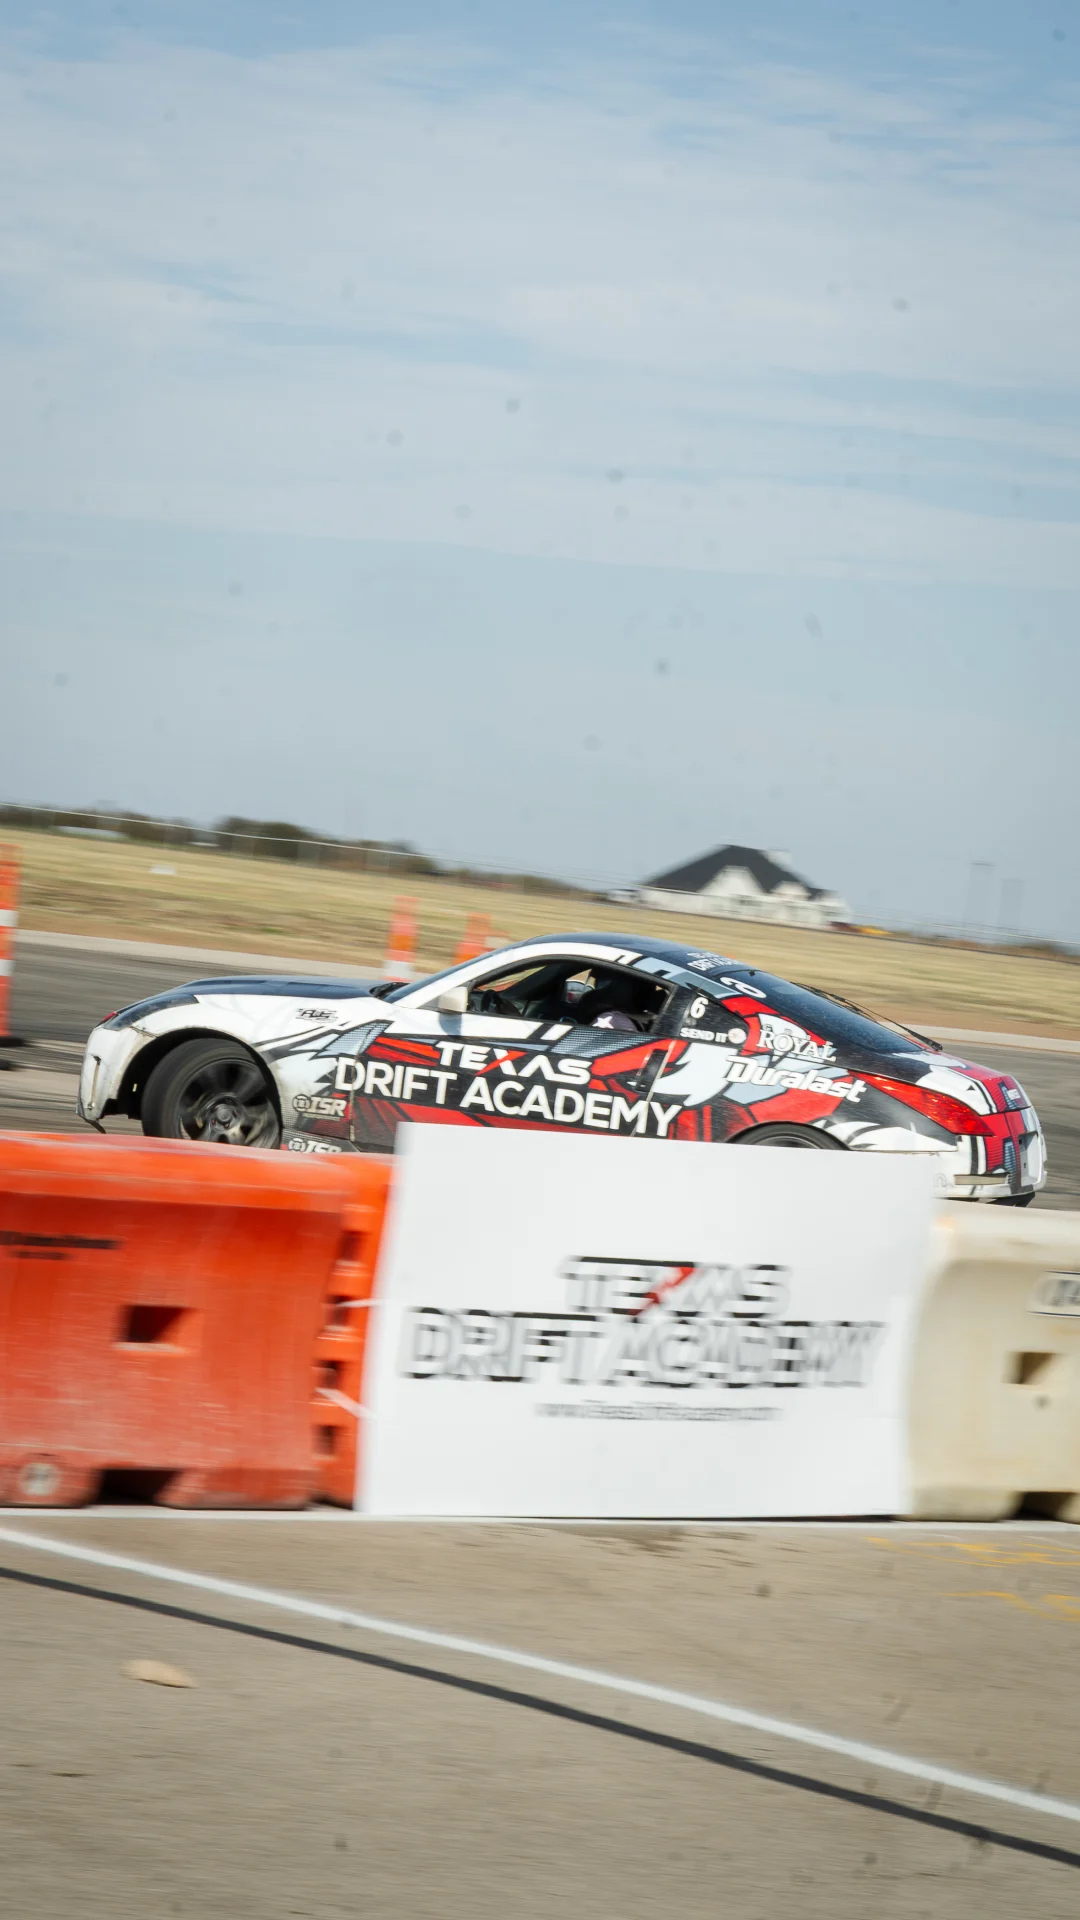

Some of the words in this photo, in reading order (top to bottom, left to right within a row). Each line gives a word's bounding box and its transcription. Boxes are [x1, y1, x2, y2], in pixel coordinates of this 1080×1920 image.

[690, 997, 709, 1019] 6
[680, 1027, 715, 1041] SEND
[714, 1031, 729, 1043] IT
[756, 1029, 837, 1062] ROYAL
[435, 1041, 593, 1085] TEXAS
[723, 1055, 868, 1103] Duralast
[334, 1057, 458, 1105] DRIFT
[458, 1076, 683, 1138] ACADEMY
[560, 1256, 790, 1319] TEXAS
[400, 1306, 604, 1386] DRIFT
[596, 1318, 886, 1390] ACADEMY
